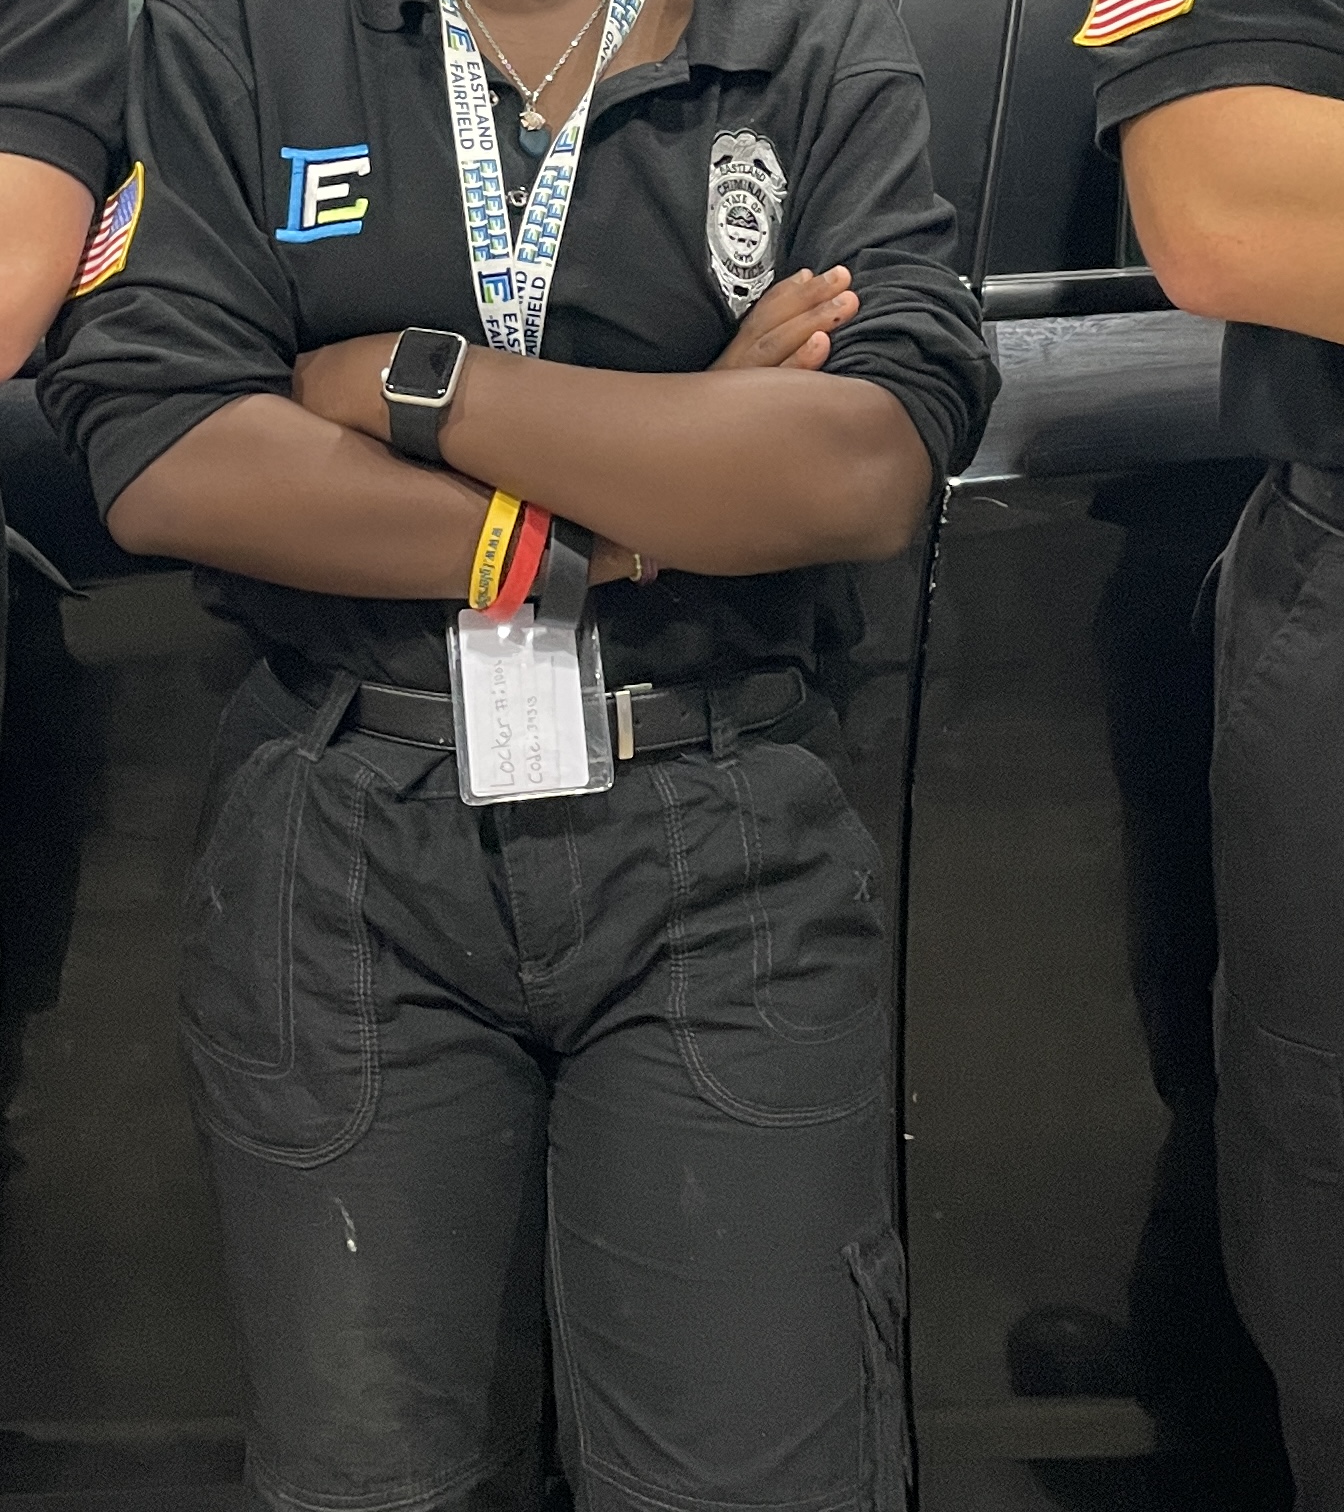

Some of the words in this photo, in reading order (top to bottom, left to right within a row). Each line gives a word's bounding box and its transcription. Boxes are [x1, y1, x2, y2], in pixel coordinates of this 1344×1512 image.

[467, 61, 494, 151] EASTLAND
[717, 179, 768, 207] CRIMINAL
[722, 194, 748, 210] STATE
[722, 259, 765, 279] JUSTICE
[525, 276, 546, 356] AIRFIELD
[490, 718, 515, 787] Locker
